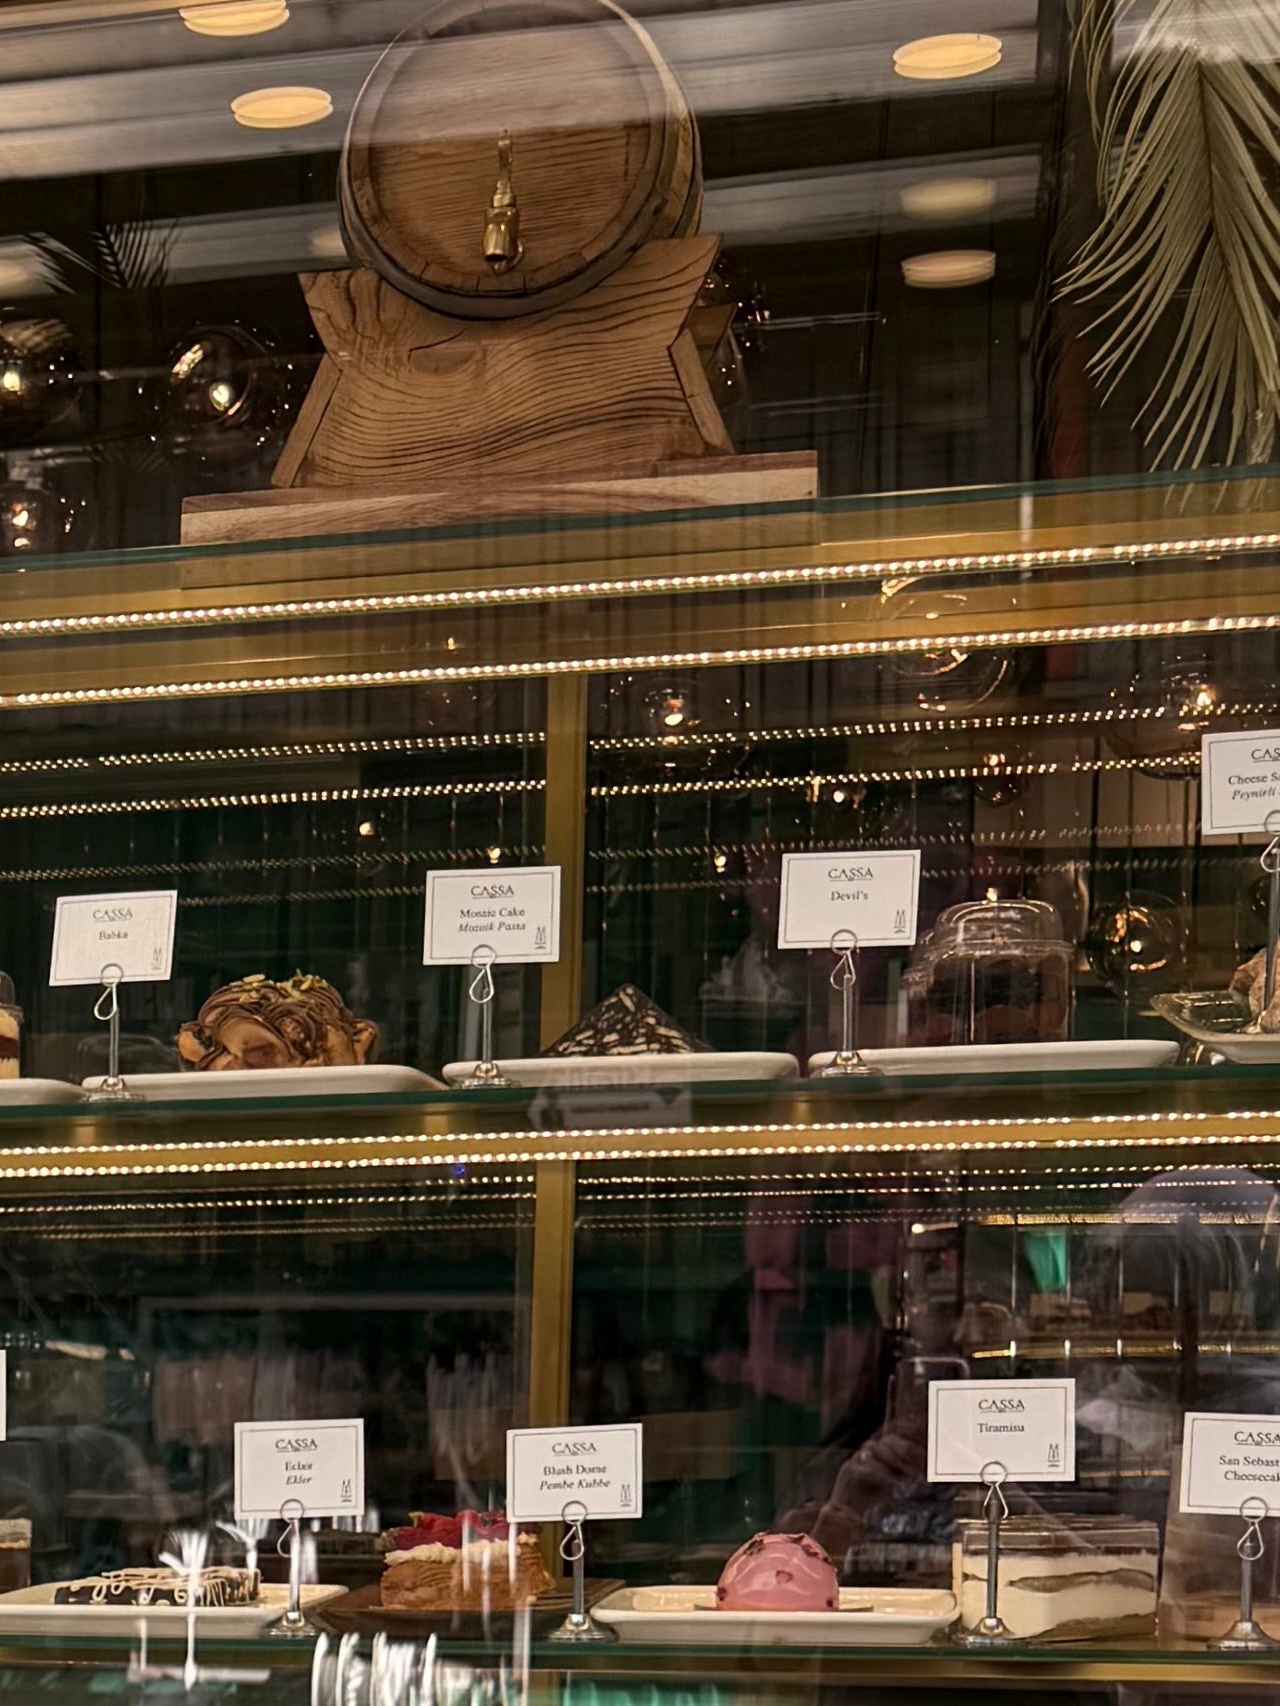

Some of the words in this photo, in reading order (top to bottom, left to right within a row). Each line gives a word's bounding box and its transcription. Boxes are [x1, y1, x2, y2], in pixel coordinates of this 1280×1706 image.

[1228, 774, 1268, 785] Cheese
[1271, 772, 1280, 782] S
[1232, 786, 1276, 802] Peynirli
[827, 867, 873, 881] CASSA
[470, 885, 514, 898] CASSA
[830, 890, 869, 901] Devil's
[93, 908, 133, 921] CASSA
[460, 908, 496, 918] Mosaic
[499, 906, 525, 917] Cake
[458, 922, 494, 932] Mozaik
[978, 1399, 1025, 1413] CASSA
[977, 1422, 1025, 1433] Tiramisu
[275, 1438, 318, 1452] CASSA
[552, 1442, 597, 1456] CASSA
[1219, 1455, 1240, 1466] San
[576, 1464, 607, 1475] Dome
[539, 1480, 574, 1490] Pembe
[577, 1478, 611, 1489] Kubbe
